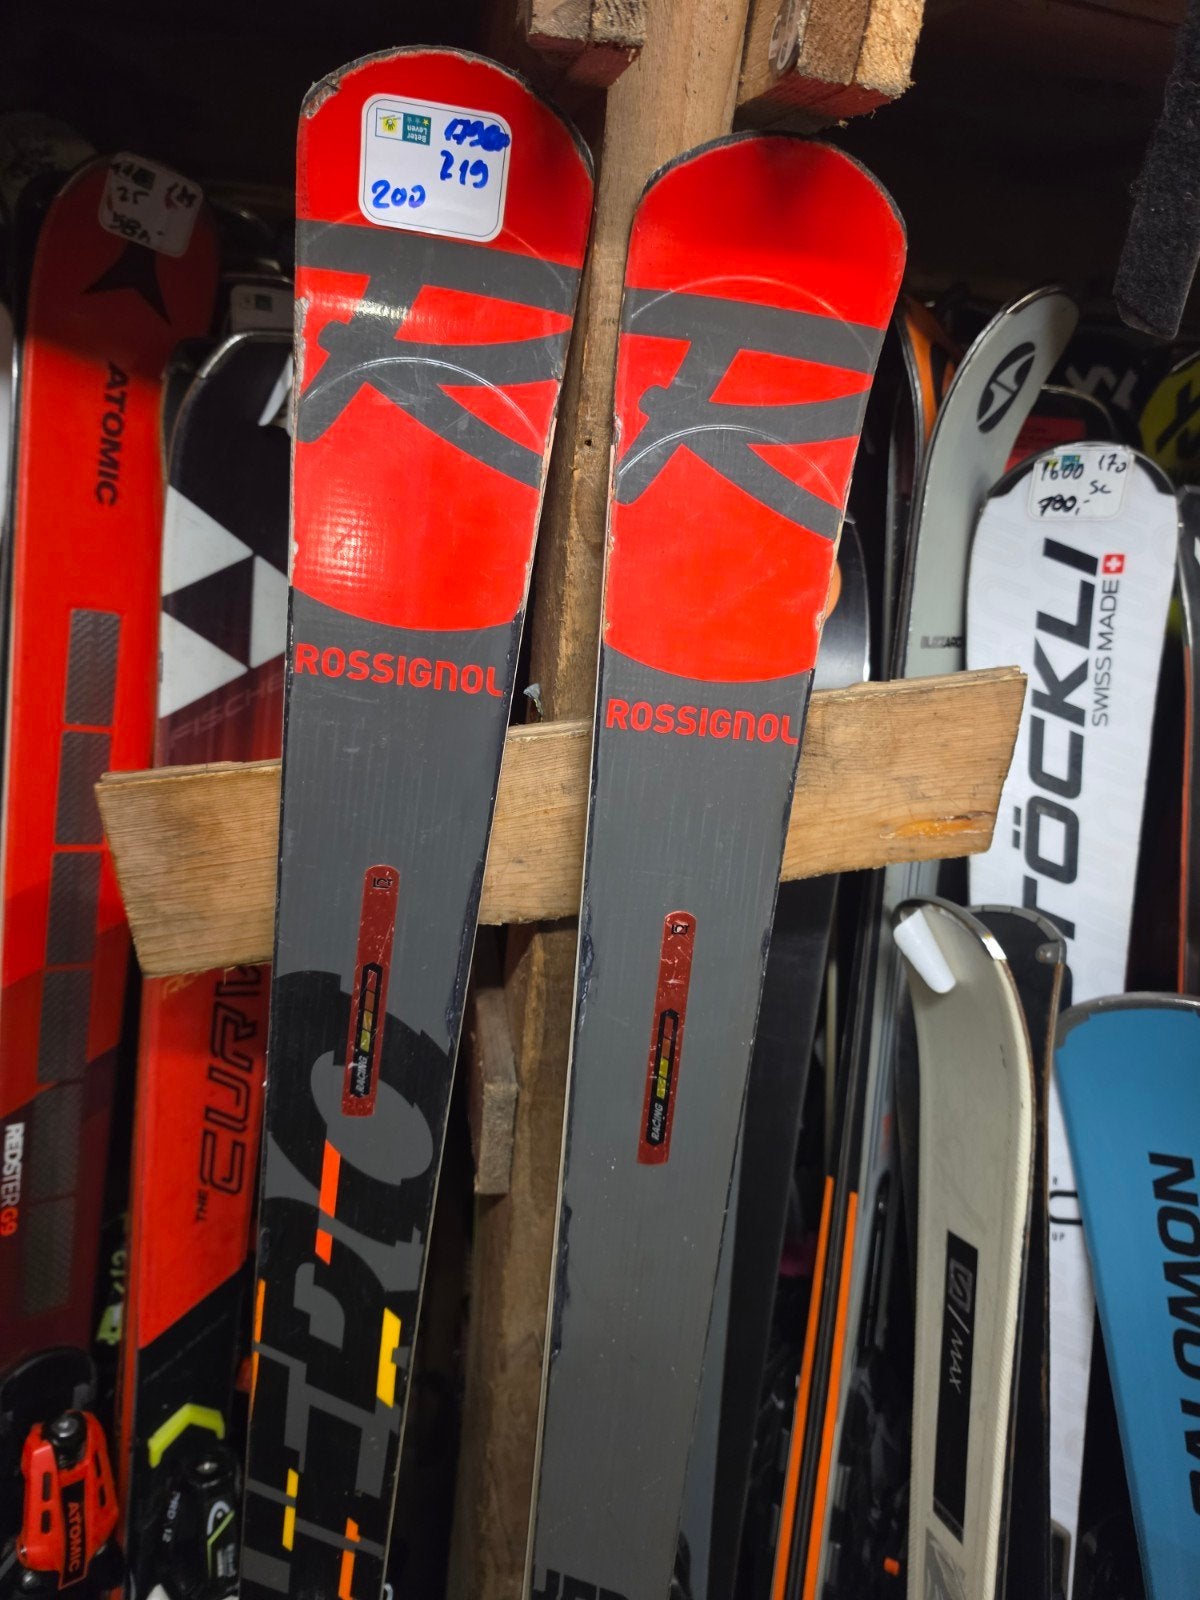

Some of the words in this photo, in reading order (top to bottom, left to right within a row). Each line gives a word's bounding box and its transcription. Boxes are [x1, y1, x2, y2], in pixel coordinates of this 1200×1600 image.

[371, 179, 426, 209] 200
[439, 149, 489, 189] 219
[95, 361, 130, 507] ATOMIC
[1040, 460, 1085, 482] 1600
[1098, 579, 1120, 652] MADE
[294, 642, 504, 698] ROSSIGNOL
[1092, 656, 1113, 727] SWISS
[605, 698, 799, 746] ROSSIGNOL
[1012, 537, 1099, 941] TÖCKLI
[354, 1055, 369, 1093] RACING
[650, 1102, 664, 1141] RACING
[0, 1122, 25, 1208] REDSTER
[0, 1206, 18, 1237] G9
[67, 1502, 83, 1573] ATOMIC
